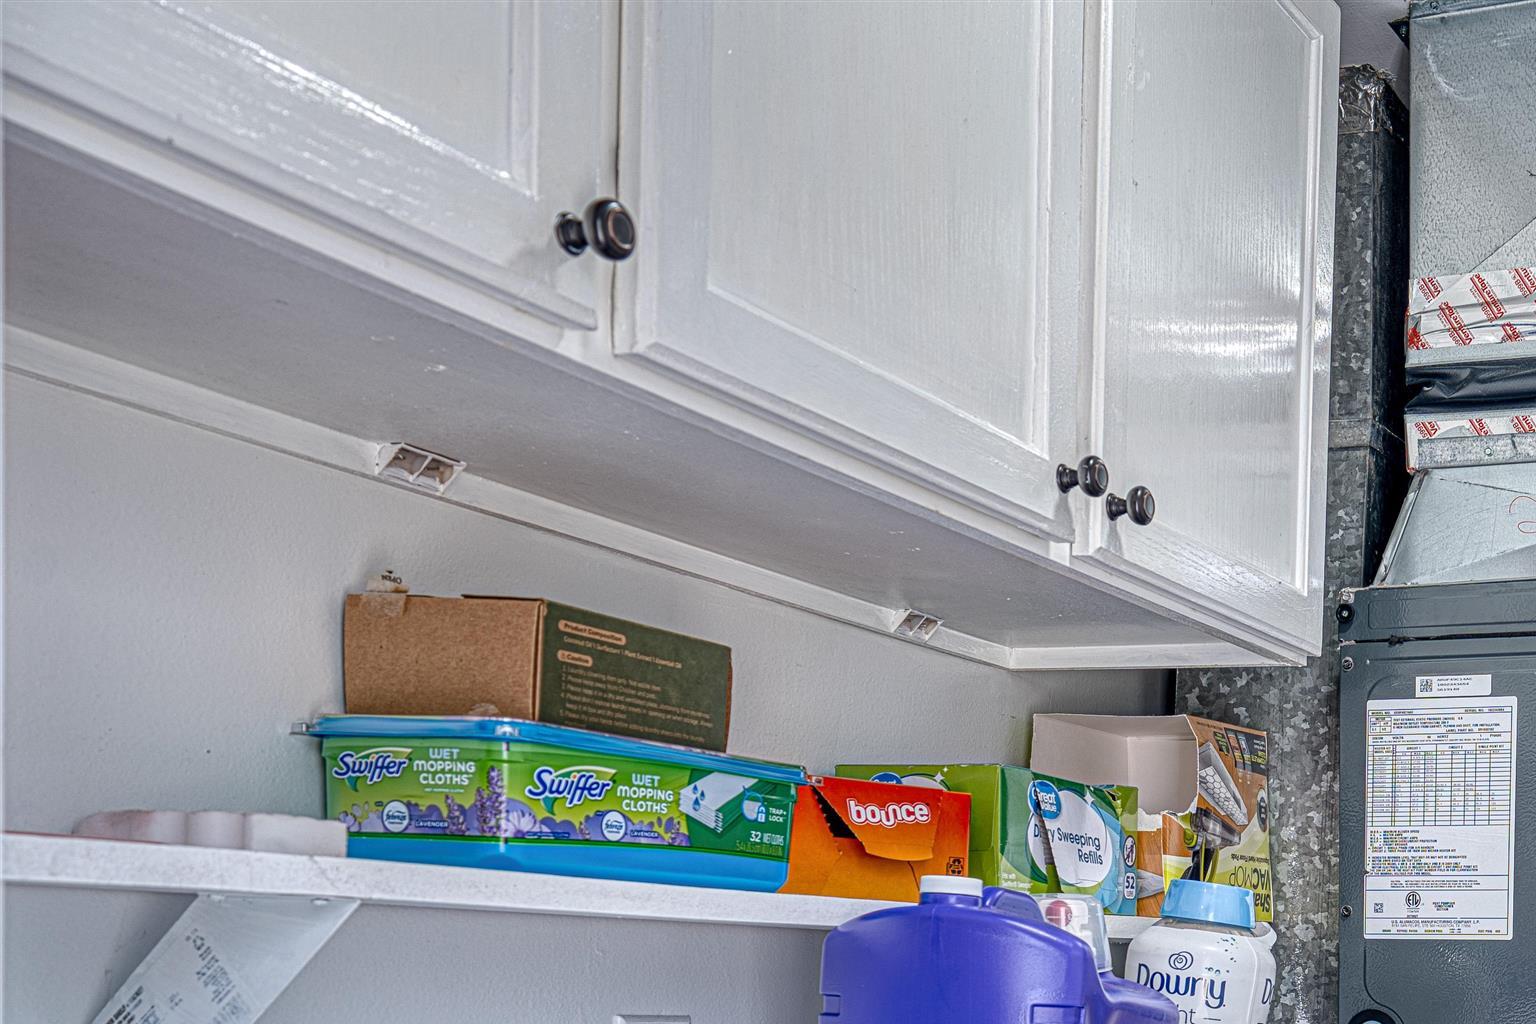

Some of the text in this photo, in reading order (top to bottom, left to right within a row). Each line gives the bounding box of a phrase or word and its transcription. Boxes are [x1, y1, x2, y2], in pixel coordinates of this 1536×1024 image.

[429, 748, 459, 759] WET
[333, 751, 408, 784] Swiffer
[413, 760, 475, 773] MOPPING
[420, 774, 469, 785] CLOTHS
[632, 773, 660, 785] WET
[525, 766, 611, 808] Swiffer
[617, 786, 674, 800] MOPPING
[622, 801, 668, 813] CLOTHS
[847, 798, 931, 828] bounce
[750, 831, 761, 842] 32
[1058, 828, 1100, 851] Sweeping
[1078, 848, 1103, 865] Refills
[1126, 876, 1135, 889] 52
[1255, 893, 1270, 913] Sha
